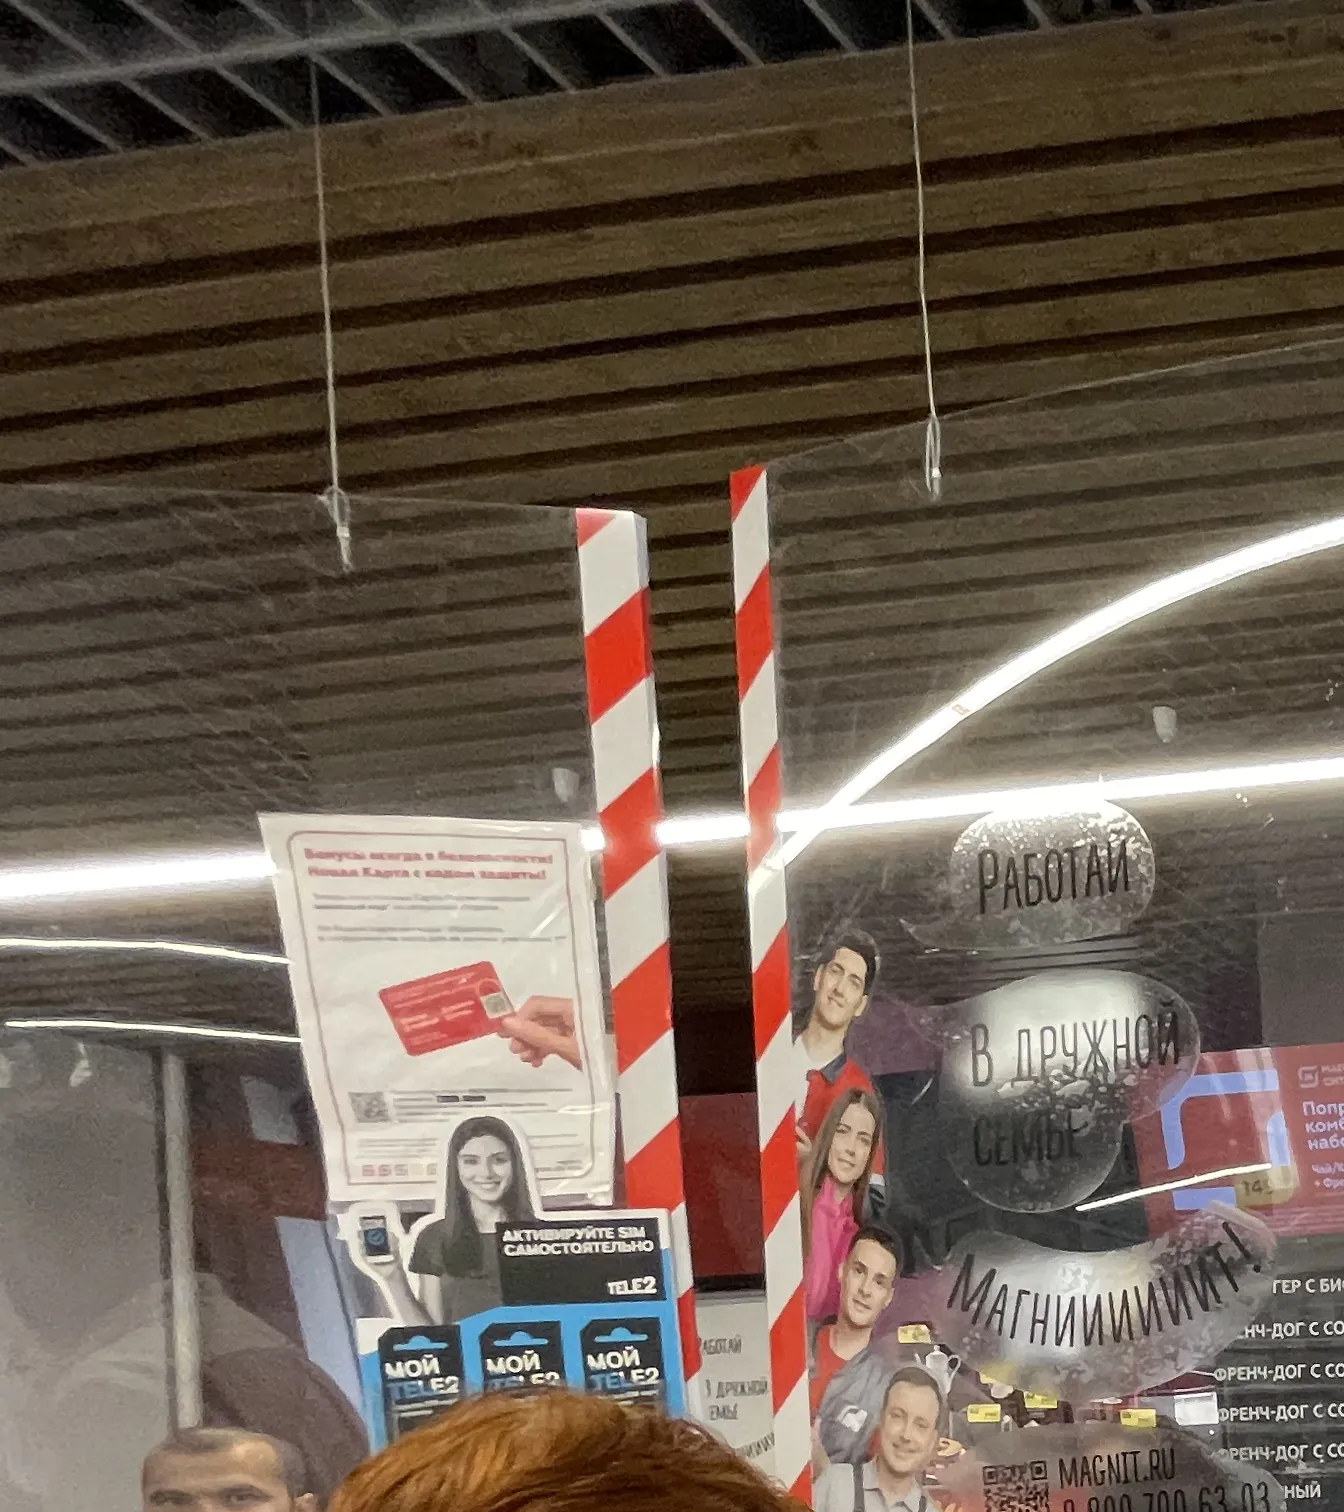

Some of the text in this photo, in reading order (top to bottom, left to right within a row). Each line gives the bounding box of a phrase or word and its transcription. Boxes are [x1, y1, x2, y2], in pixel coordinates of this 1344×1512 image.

[971, 1005, 1181, 1087] В ДРУЖНОЙ
[502, 1225, 615, 1242] АКТИВИРУЙТЕ
[504, 1240, 654, 1256] САМОСТОЯТЕЛЬНО
[607, 1276, 657, 1295] TELE2
[1305, 1278, 1317, 1293] С
[1237, 1322, 1307, 1340] НЧ-ДОГ
[1308, 1321, 1320, 1337] С
[385, 1354, 440, 1380] МОЙ
[486, 1350, 541, 1374] МОЙ
[587, 1345, 641, 1372] МОЙ
[1213, 1364, 1305, 1382] ФРЕНЧ-ДОГ
[1310, 1363, 1321, 1378] С
[1218, 1404, 1308, 1422] ФРЕНЧ-ДОГ
[1313, 1403, 1323, 1419] С
[1313, 1444, 1323, 1459] С
[1058, 1448, 1176, 1489] MAGNIT.RU
